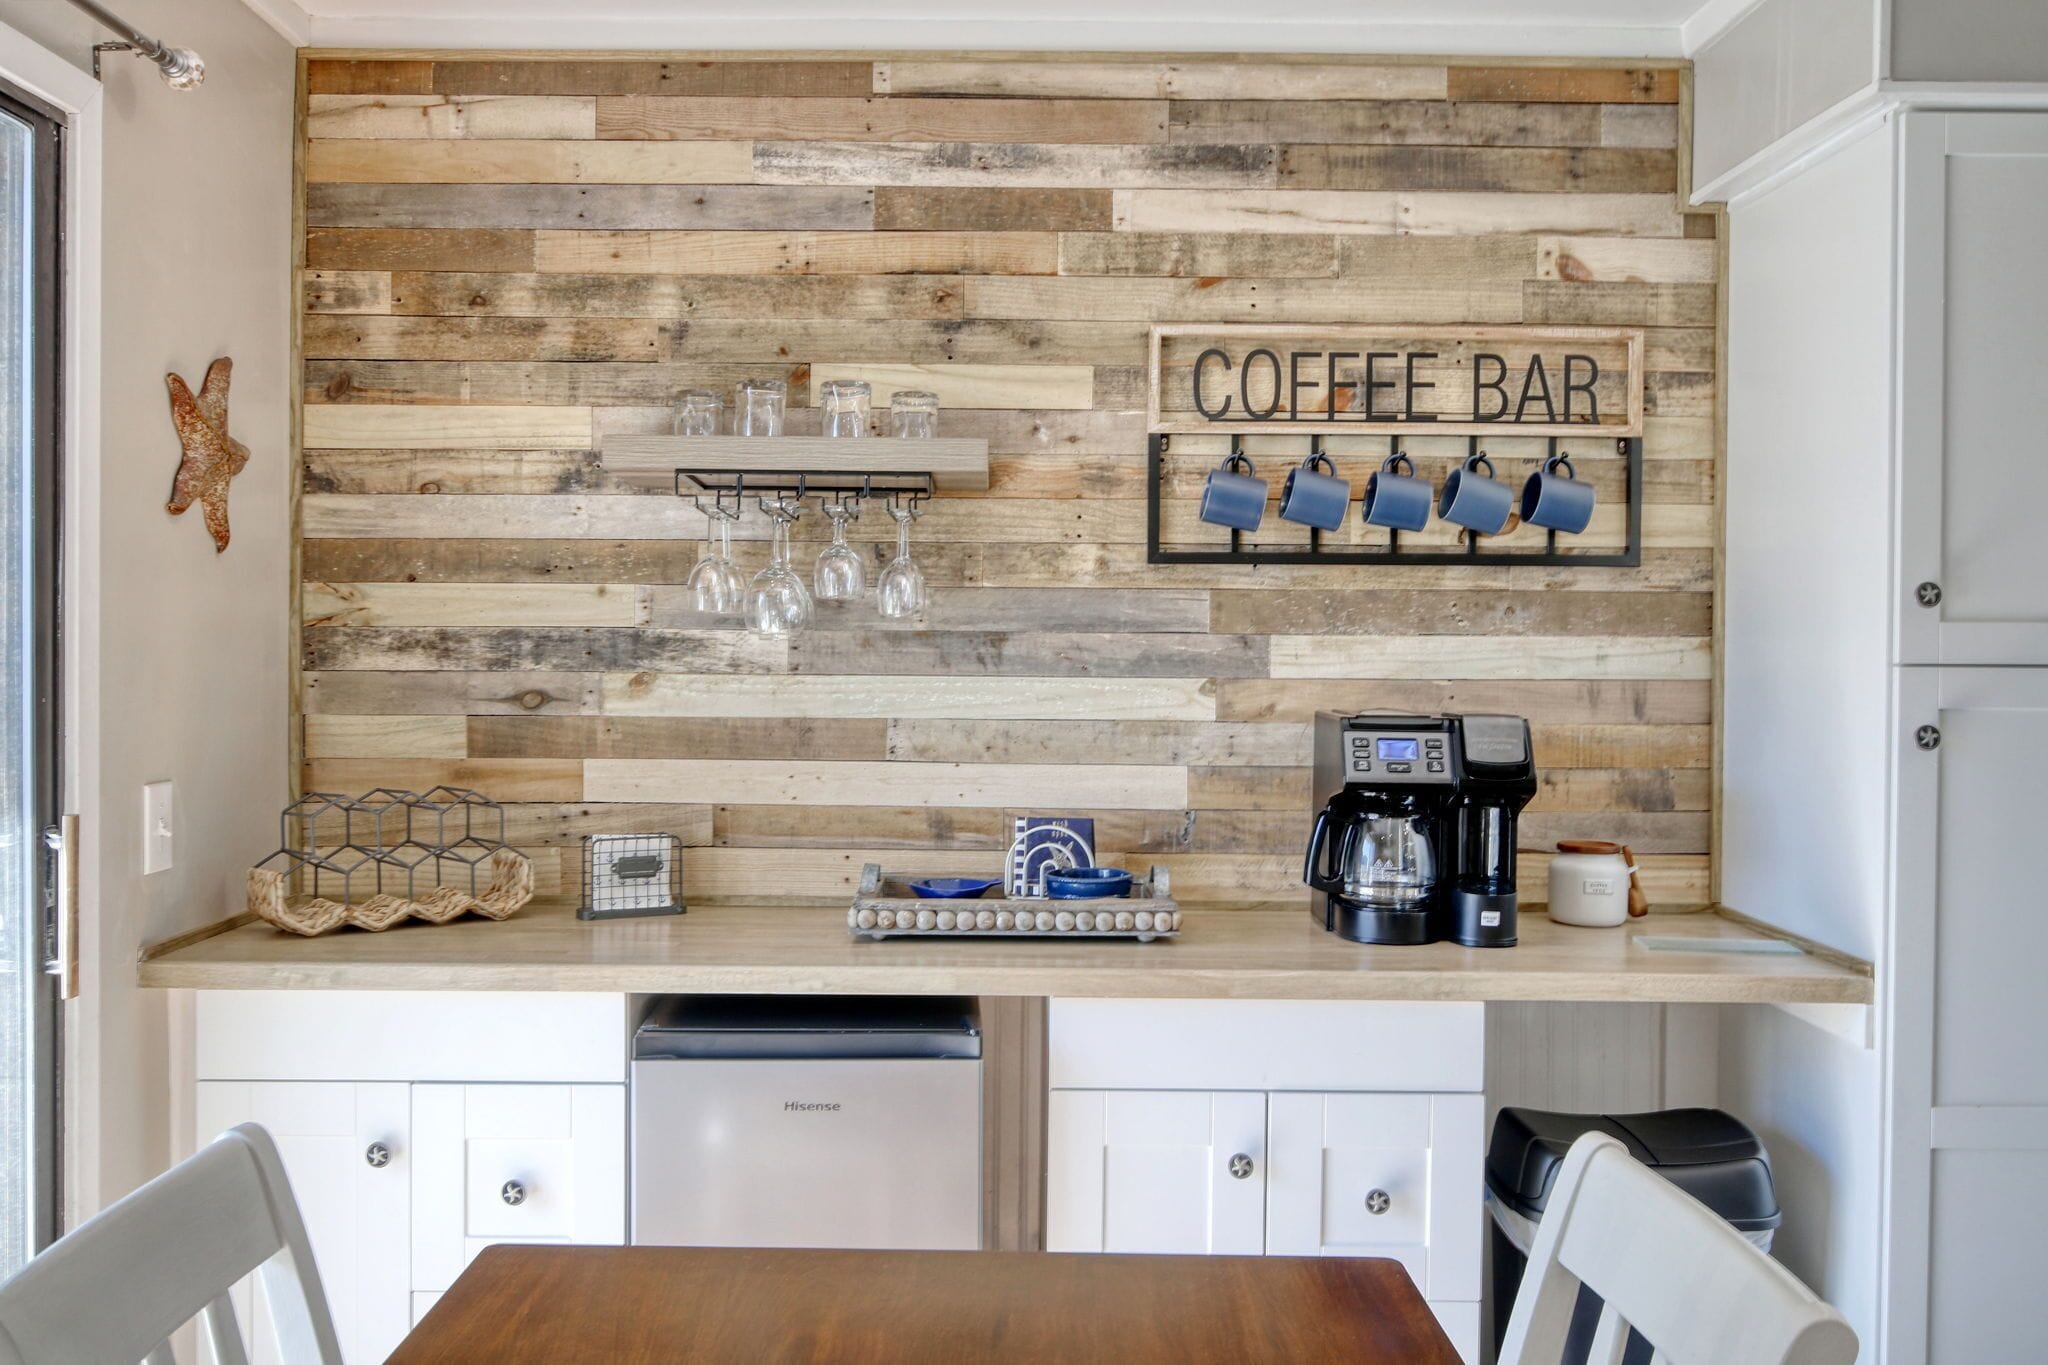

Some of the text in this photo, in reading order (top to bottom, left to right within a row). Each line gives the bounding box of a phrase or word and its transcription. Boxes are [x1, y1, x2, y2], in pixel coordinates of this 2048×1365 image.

[1193, 348, 1602, 424] COFFEE BAR
[784, 1101, 841, 1111] Hisense
